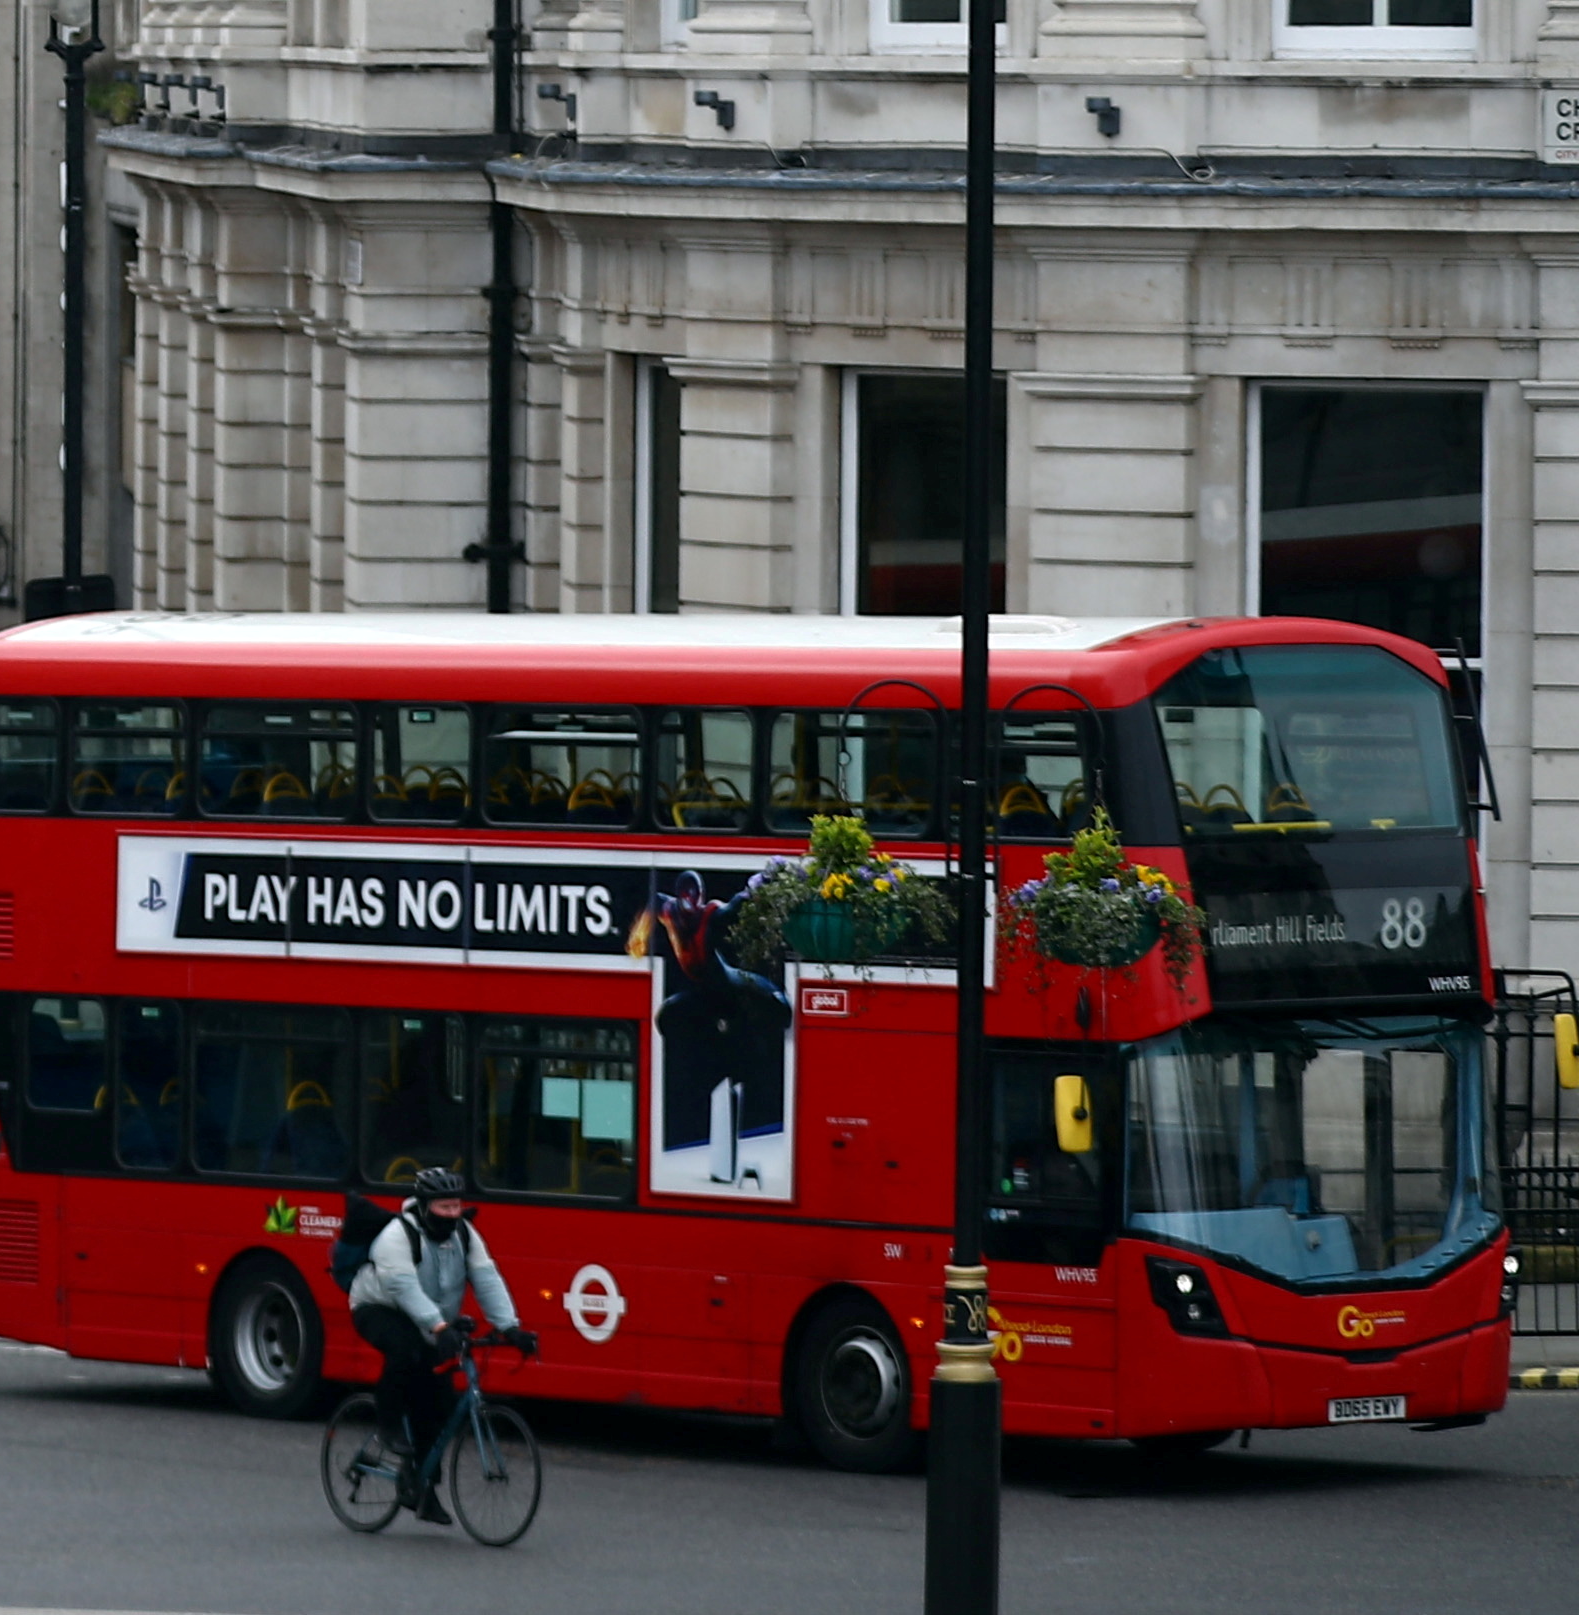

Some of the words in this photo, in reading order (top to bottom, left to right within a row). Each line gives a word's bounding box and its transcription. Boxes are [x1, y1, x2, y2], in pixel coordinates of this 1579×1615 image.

[203, 873, 297, 924] PLAY
[307, 876, 385, 928] HAS
[397, 879, 463, 931] NO
[1211, 918, 1274, 947] rliament
[1276, 915, 1302, 944] Hill
[1306, 913, 1346, 943] Fields
[1380, 897, 1428, 950] 88
[1427, 975, 1472, 993] WHV95
[884, 1243, 903, 1261] SW
[1054, 1266, 1099, 1284] WHV95
[1337, 1305, 1374, 1337] Go
